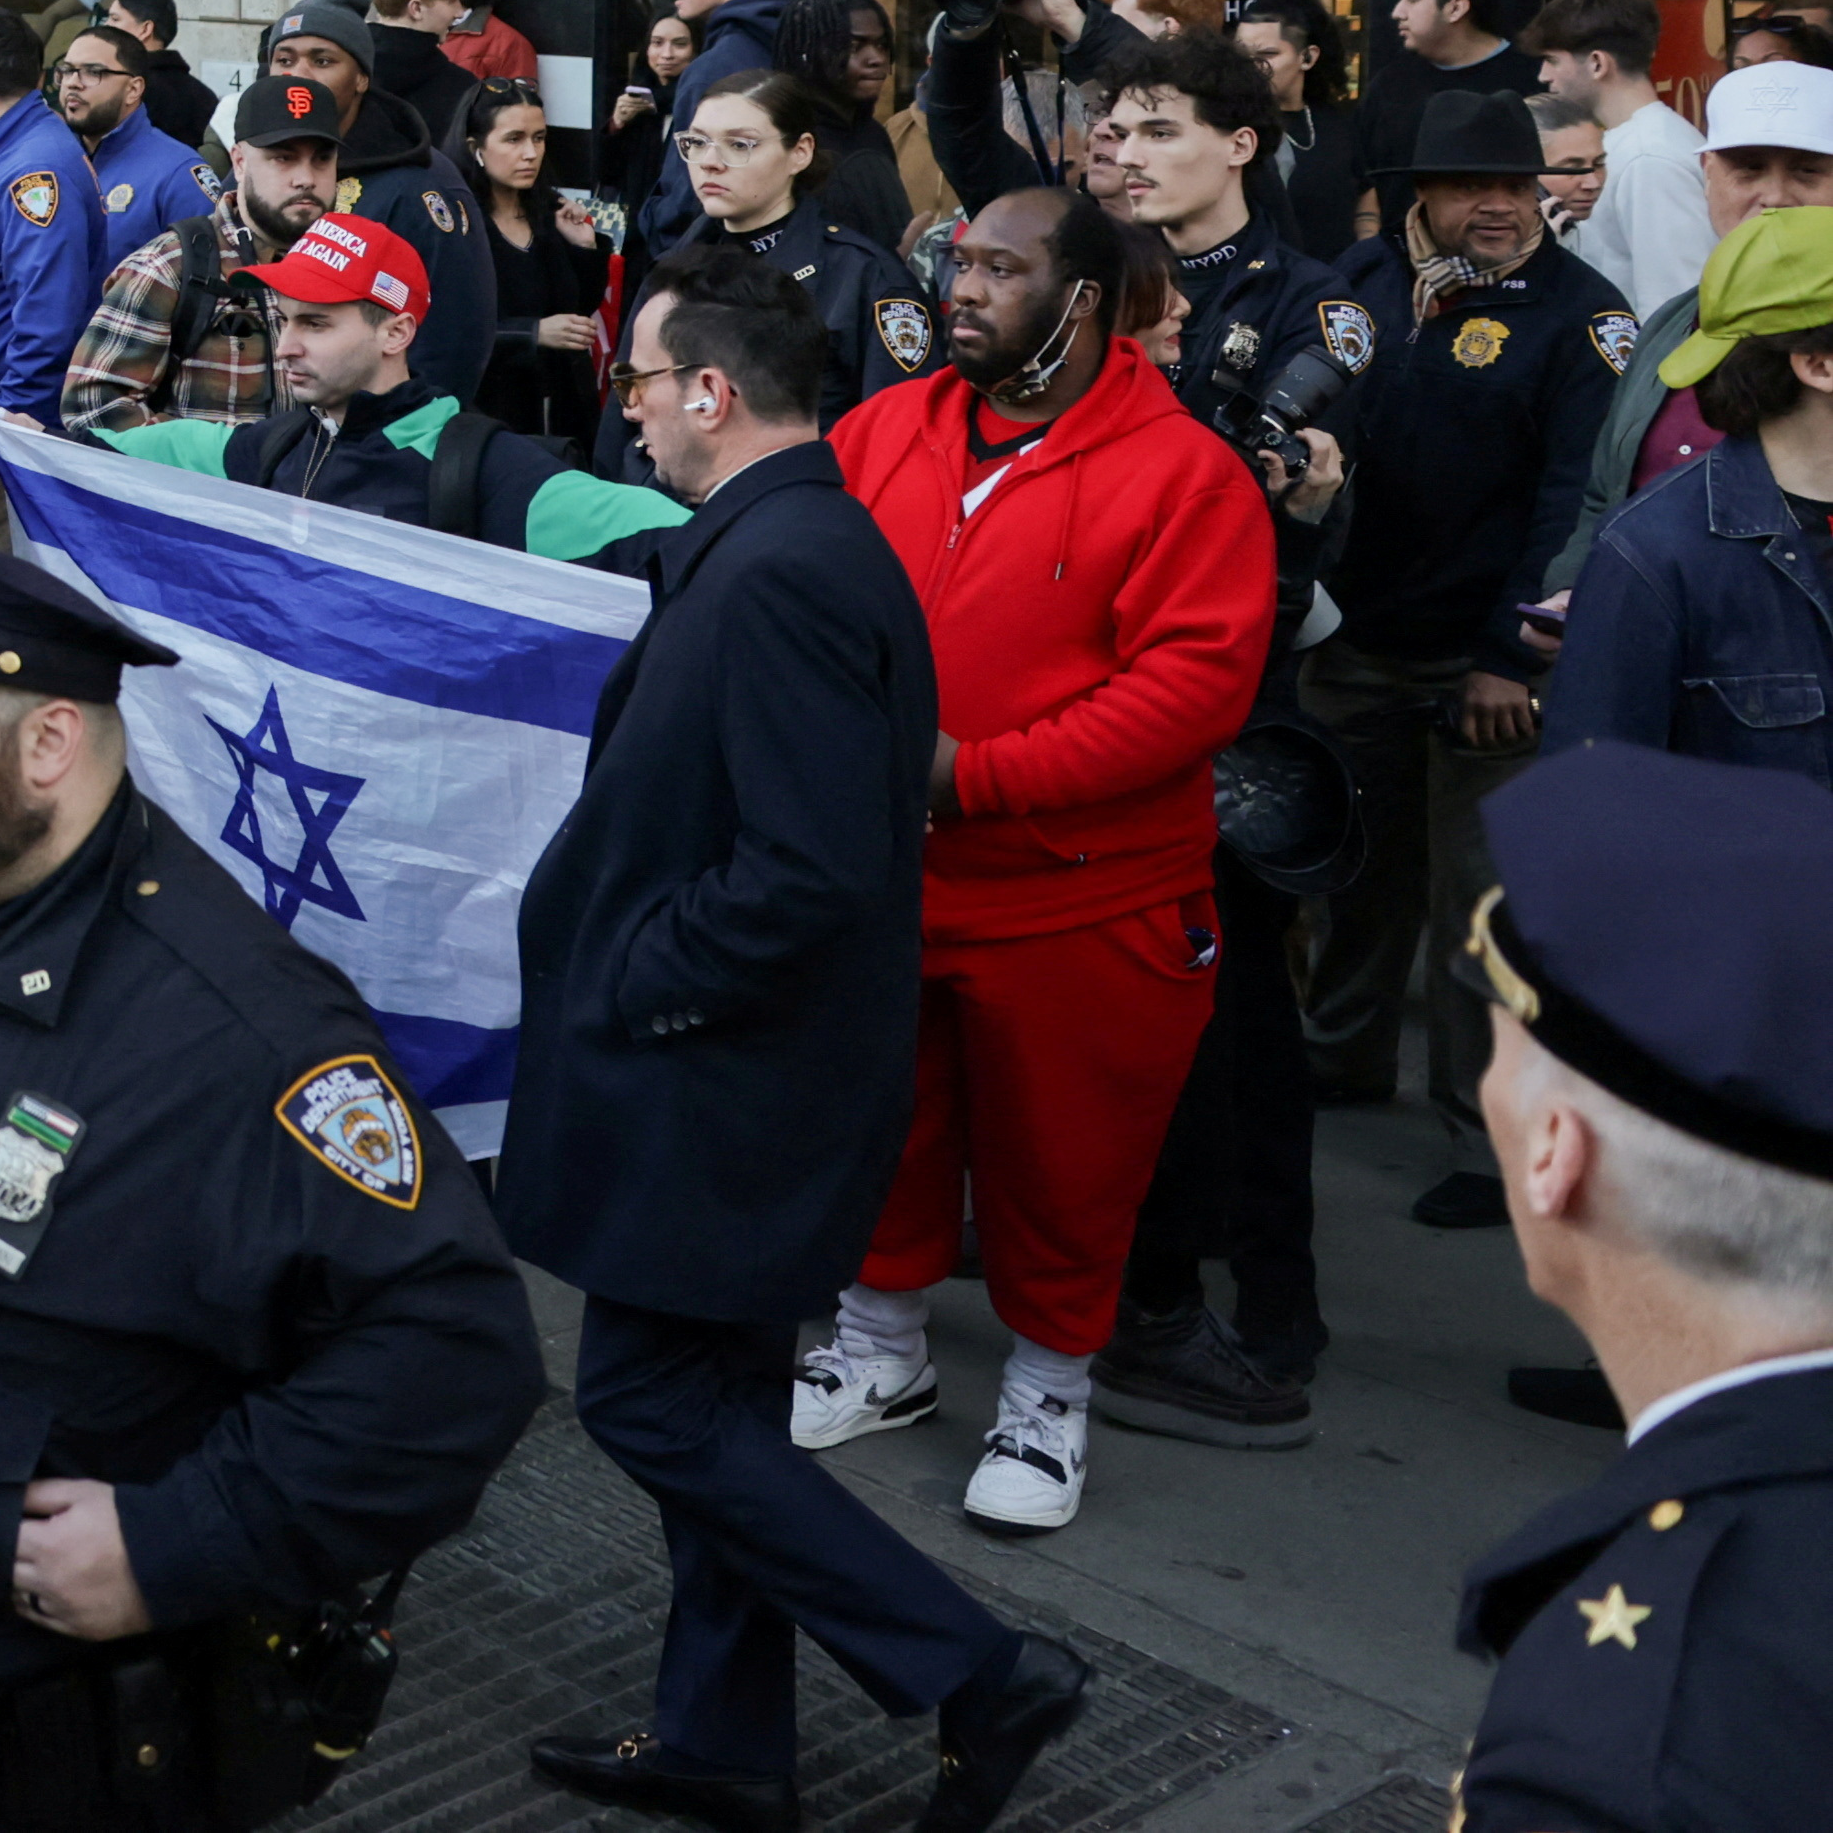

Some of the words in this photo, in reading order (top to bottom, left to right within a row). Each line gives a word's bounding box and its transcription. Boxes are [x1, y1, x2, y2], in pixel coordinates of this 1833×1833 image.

[229, 70, 242, 91] 4
[749, 229, 783, 253] NY
[305, 240, 351, 272] AGAIN
[1180, 244, 1238, 270] NYPD
[1502, 280, 1527, 290] PSB
[302, 1067, 358, 1104] POLICE
[322, 1143, 361, 1177] CITY
[361, 1170, 388, 1192] OF
